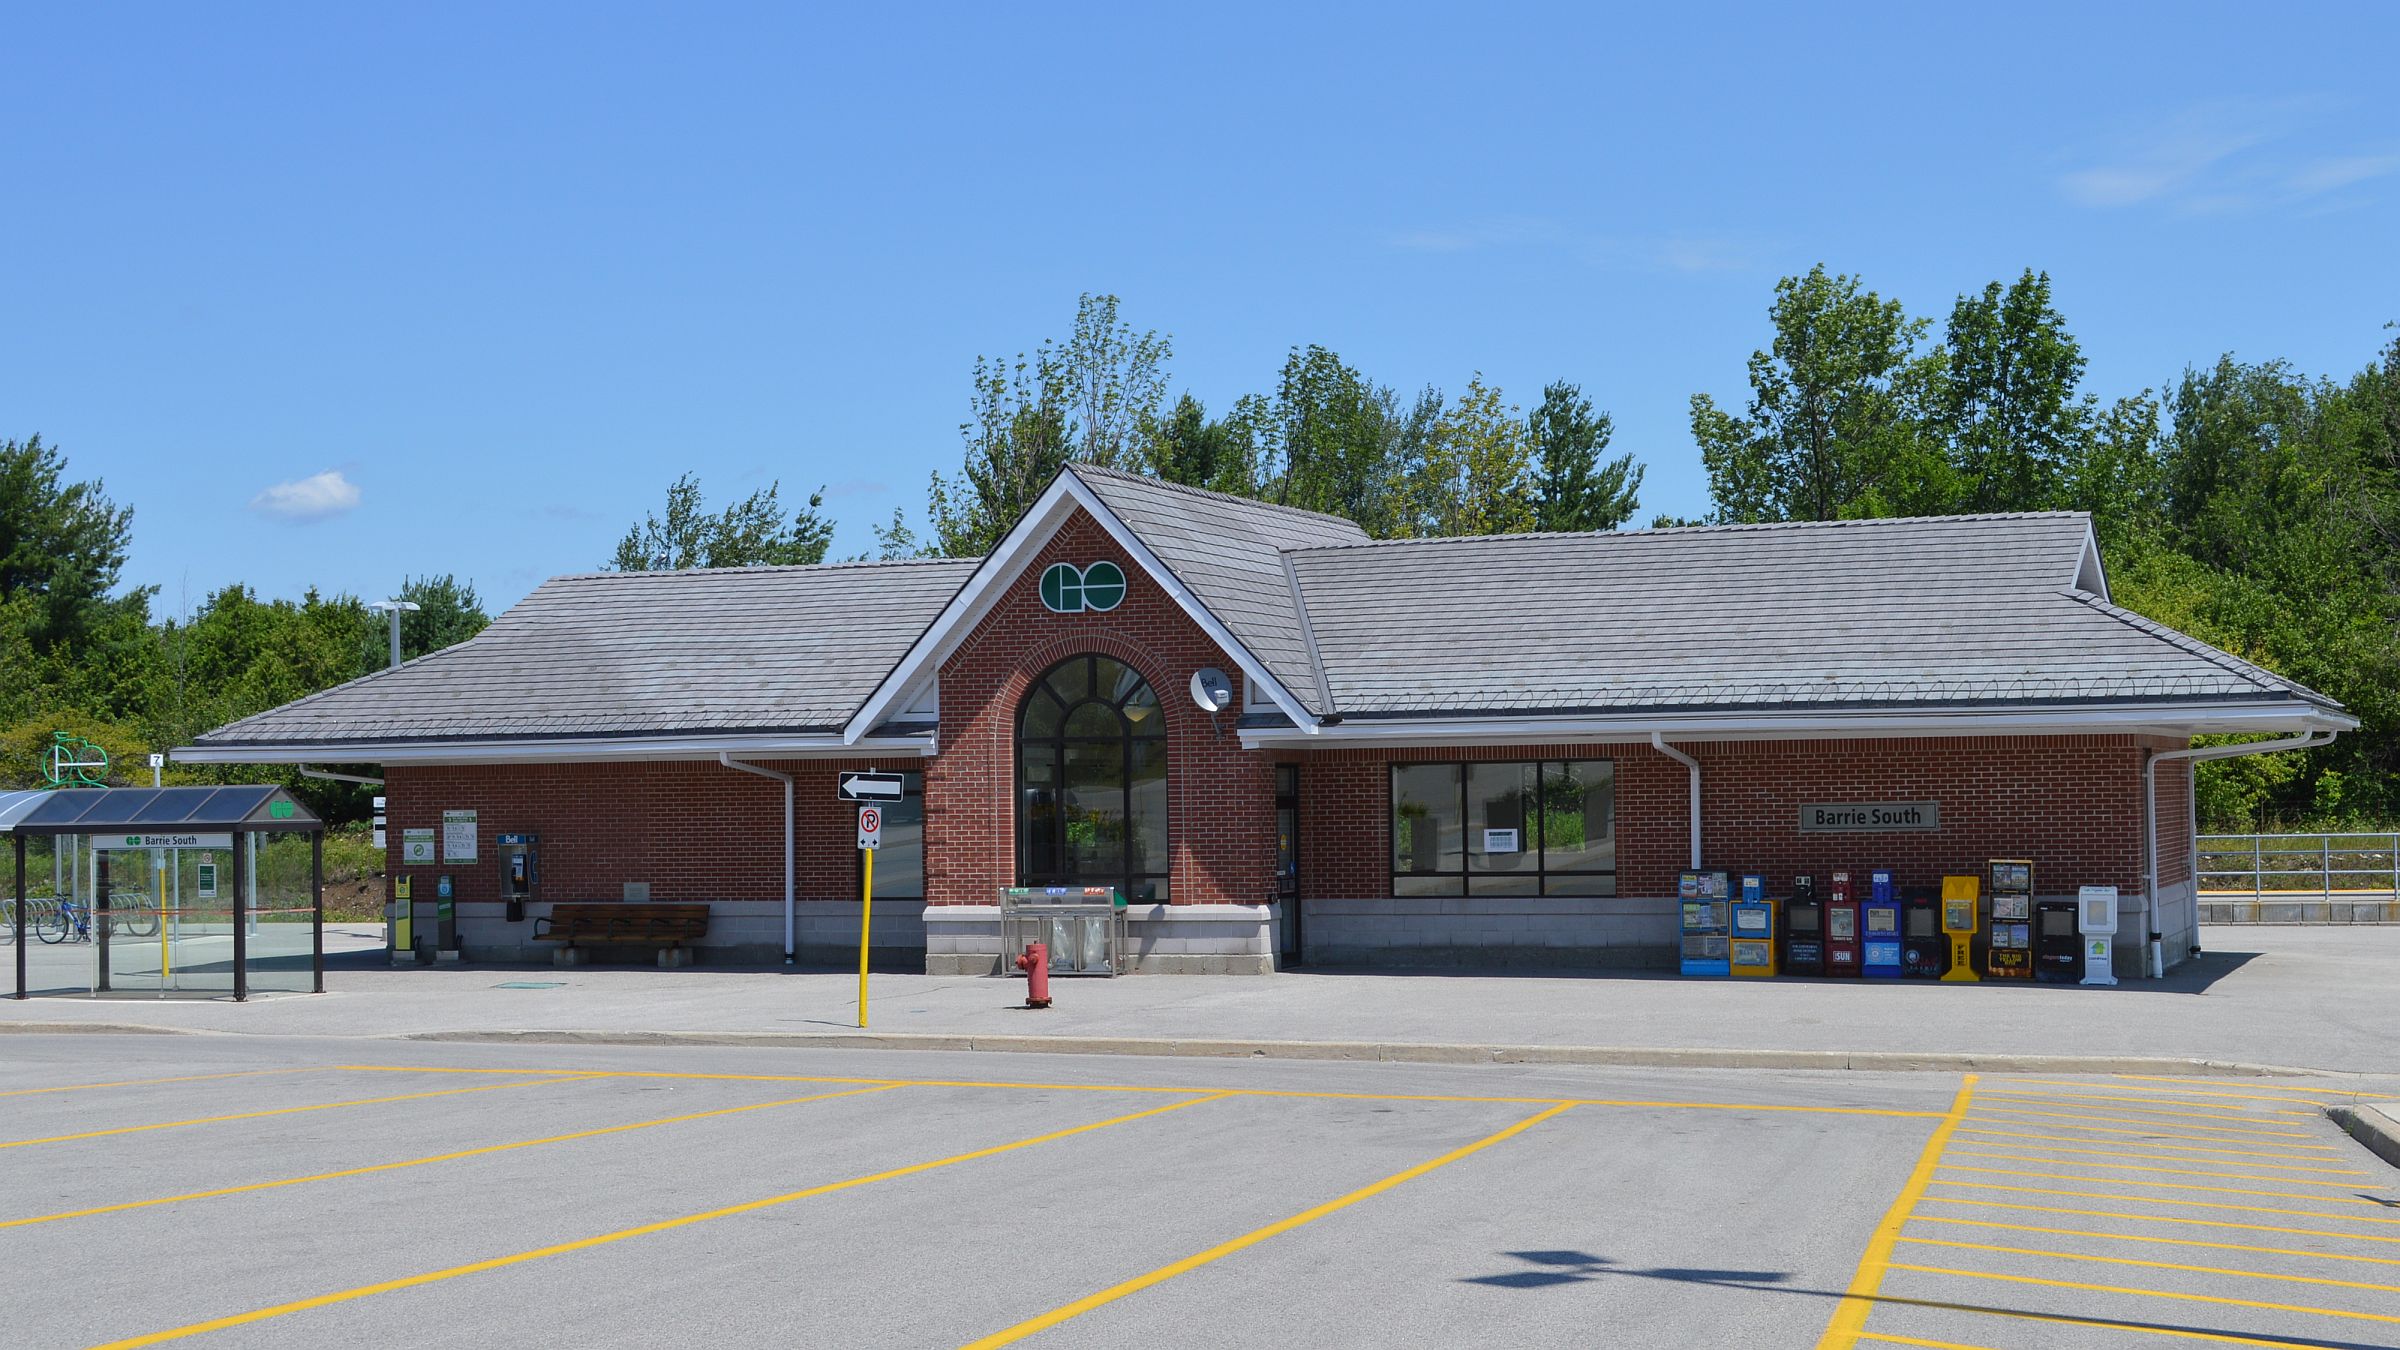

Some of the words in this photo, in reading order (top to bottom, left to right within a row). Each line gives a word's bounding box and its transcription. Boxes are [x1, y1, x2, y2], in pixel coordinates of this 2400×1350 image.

[1201, 676, 1218, 688] Bell
[1815, 808, 1867, 825] Barrie
[1871, 807, 1922, 824] South
[145, 836, 170, 846] Barrie
[172, 835, 197, 846] South
[505, 835, 518, 844] Bell
[1834, 951, 1850, 961] SUN
